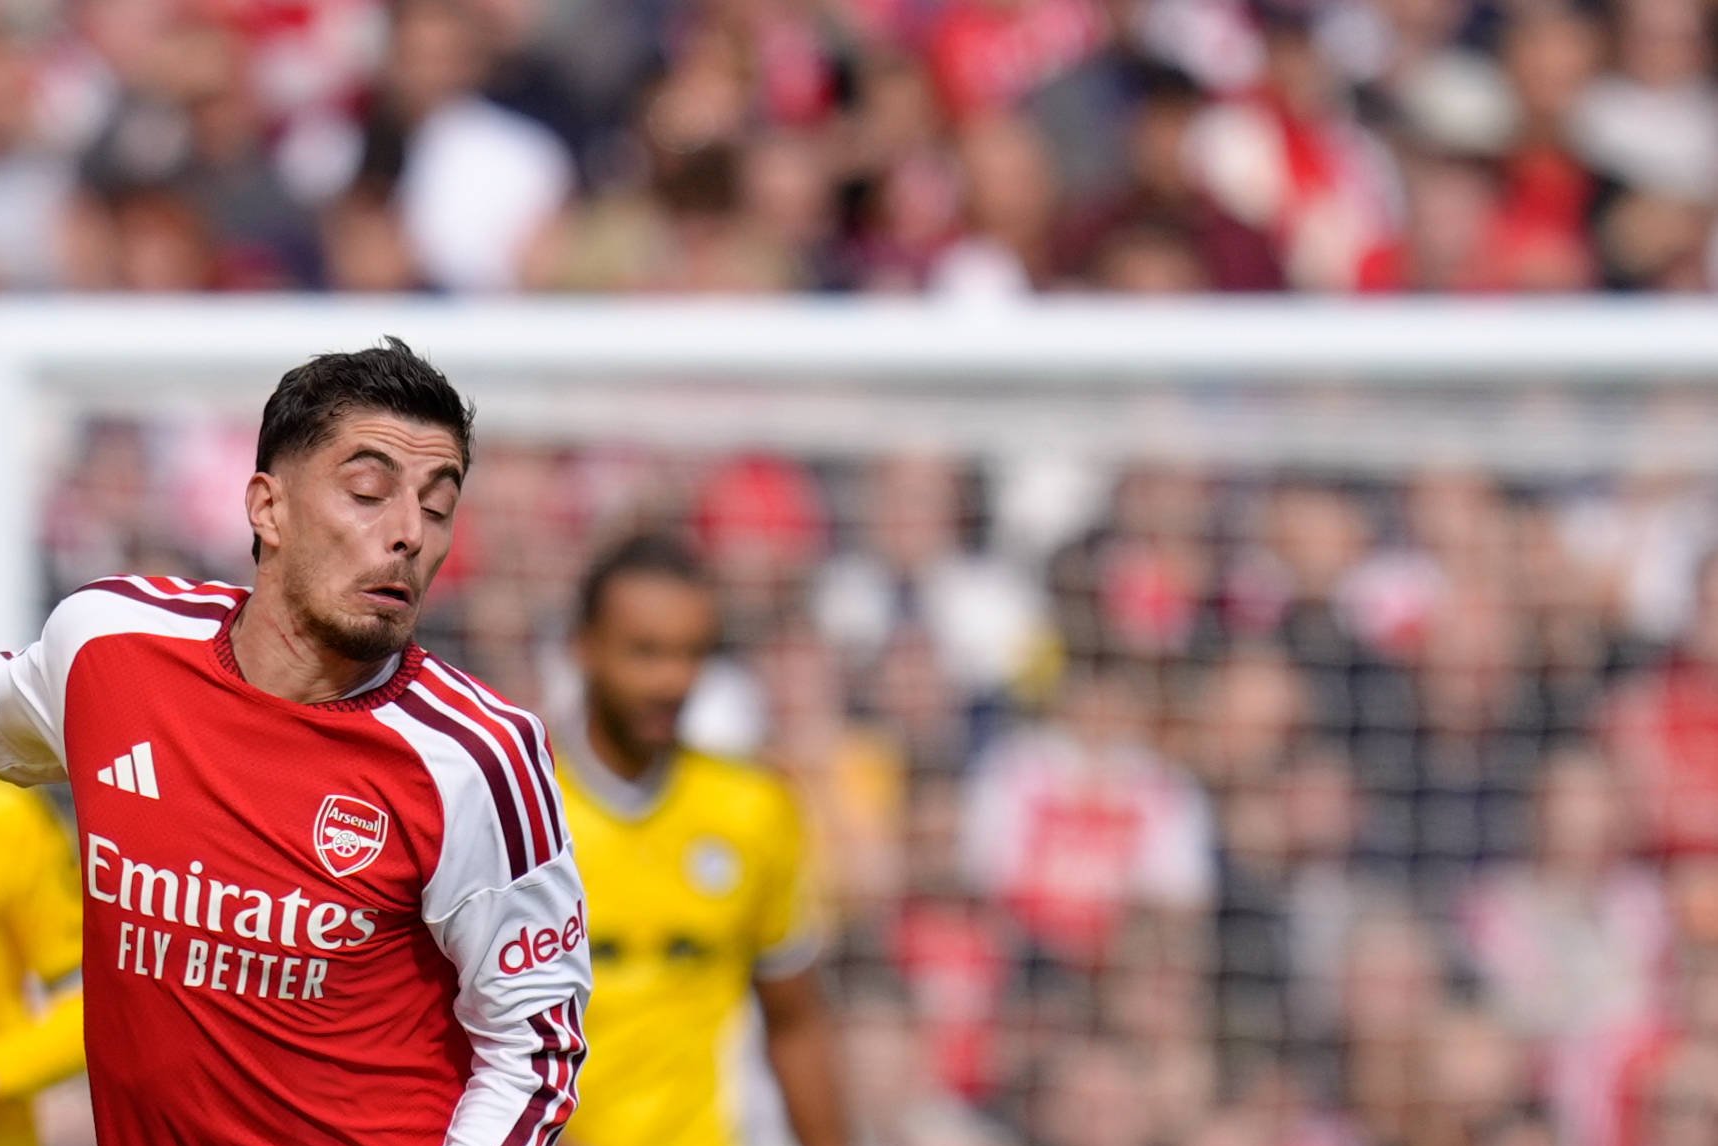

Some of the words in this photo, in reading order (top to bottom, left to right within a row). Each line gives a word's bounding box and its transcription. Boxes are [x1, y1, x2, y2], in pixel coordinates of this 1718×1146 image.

[328, 806, 379, 833] Arsenal
[87, 832, 380, 950] Emirates
[117, 921, 172, 980] FLY
[183, 938, 329, 1001] BETTER
[498, 899, 585, 975] deel
